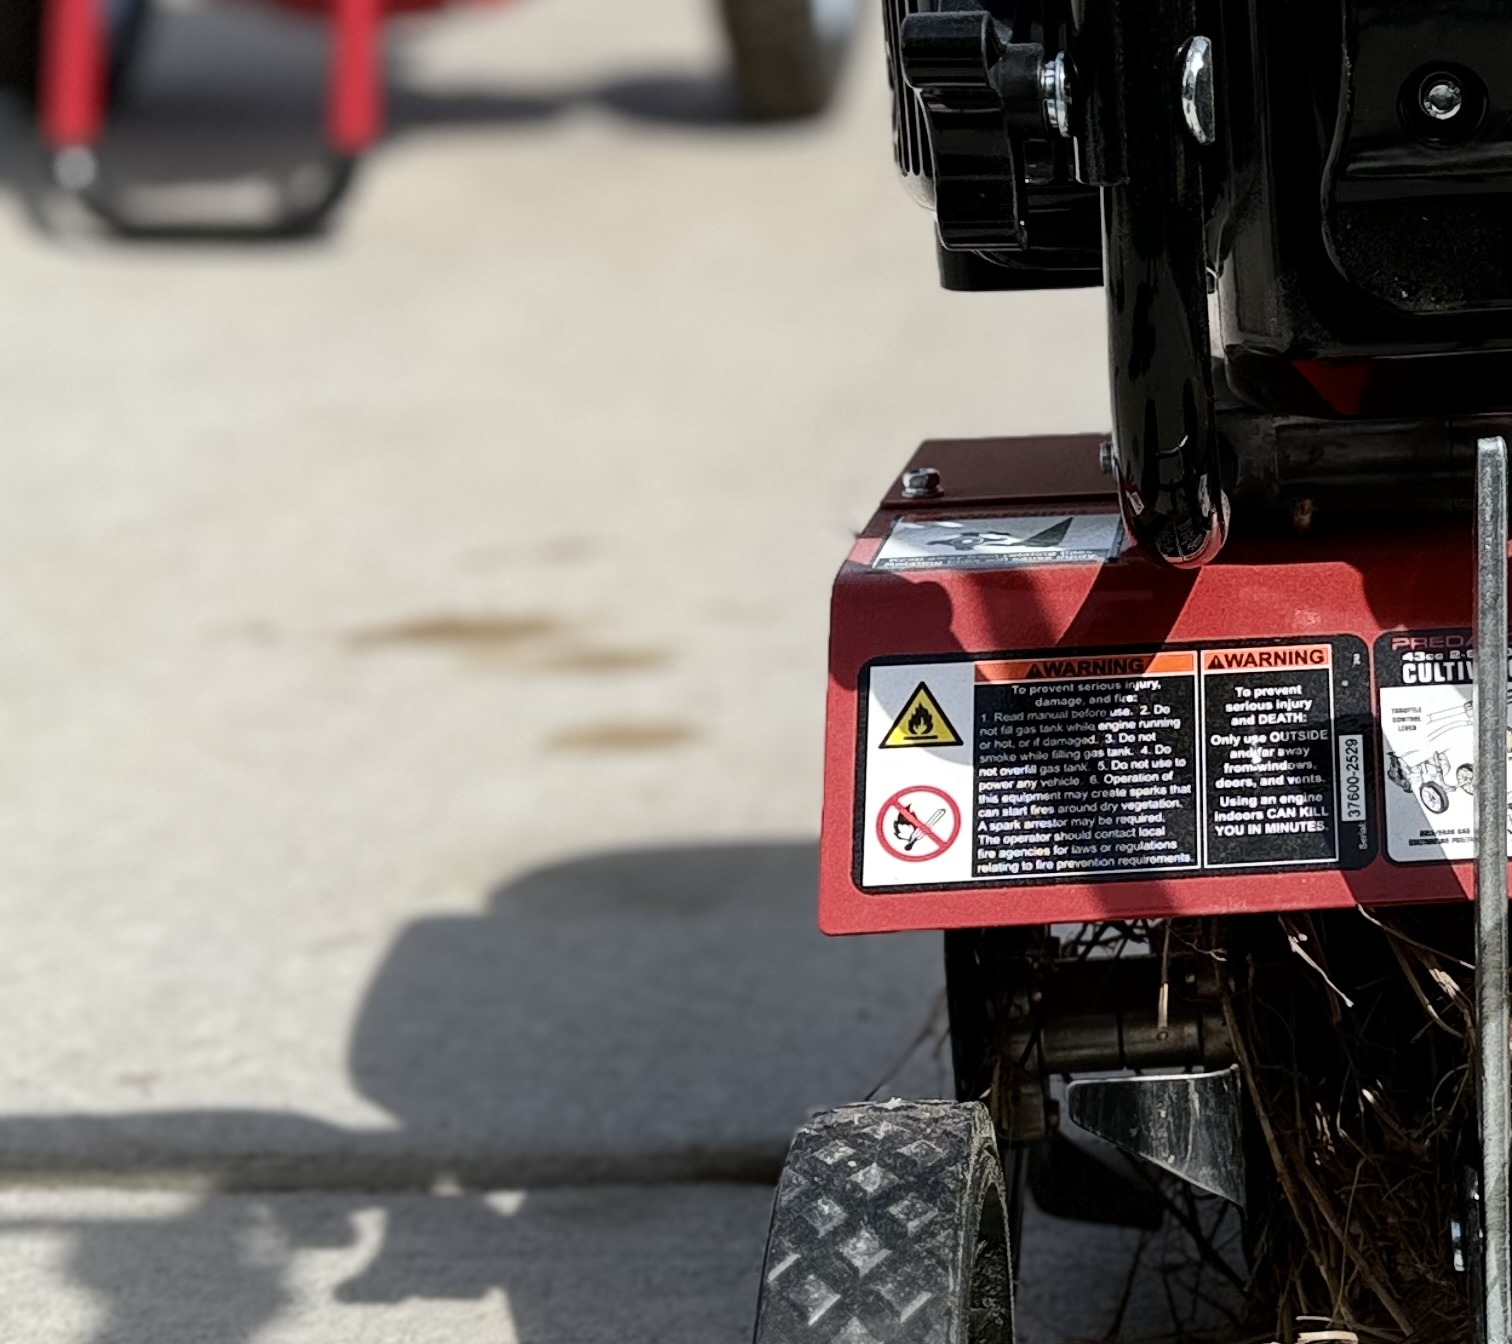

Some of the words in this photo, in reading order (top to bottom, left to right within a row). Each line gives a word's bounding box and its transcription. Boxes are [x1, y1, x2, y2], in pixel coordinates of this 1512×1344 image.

[1224, 649, 1324, 667] WARNING
[1402, 651, 1443, 661] 43cc
[1043, 658, 1144, 677] WARNING
[1030, 681, 1073, 697] prevent
[1078, 680, 1121, 692] serious
[1235, 687, 1251, 698] To
[1254, 684, 1302, 700] prevent
[1225, 700, 1272, 712] serious
[1276, 698, 1312, 712] injury
[1098, 719, 1136, 733] engine
[1139, 716, 1180, 730] running
[1231, 715, 1255, 727] and
[1211, 734, 1240, 748] Only
[1244, 734, 1266, 744] use
[1270, 729, 1328, 743] OUTSIDE
[1230, 747, 1253, 760] and
[1257, 747, 1274, 758] far
[1277, 746, 1310, 757] away
[1000, 763, 1036, 776] overfill
[1224, 763, 1256, 774] from
[1104, 771, 1159, 787] Operation
[1260, 774, 1284, 786] and
[1344, 738, 1360, 818] 37600-2529
[1002, 789, 1061, 805] equipment
[1091, 786, 1126, 798] create
[1130, 784, 1166, 799] sparks
[1220, 795, 1257, 808] Using
[1261, 795, 1277, 805] an
[1280, 792, 1322, 806] engine
[1031, 804, 1054, 815] fires
[1058, 801, 1097, 814] around
[1215, 810, 1264, 822] indoors
[1267, 807, 1296, 819] CAN
[1300, 805, 1329, 818] KILL
[990, 818, 1020, 833] spark
[1024, 816, 1067, 828] arrestor
[1215, 825, 1244, 837] YOU
[1248, 824, 1261, 835] IN
[1003, 831, 1051, 846] operator
[1054, 829, 1091, 841] should
[1095, 827, 1135, 839] contact
[1139, 825, 1165, 837] local
[1000, 845, 1050, 860] agencies
[1115, 839, 1177, 854] regulations
[978, 861, 1018, 874] relating
[1057, 856, 1114, 872] prevention
